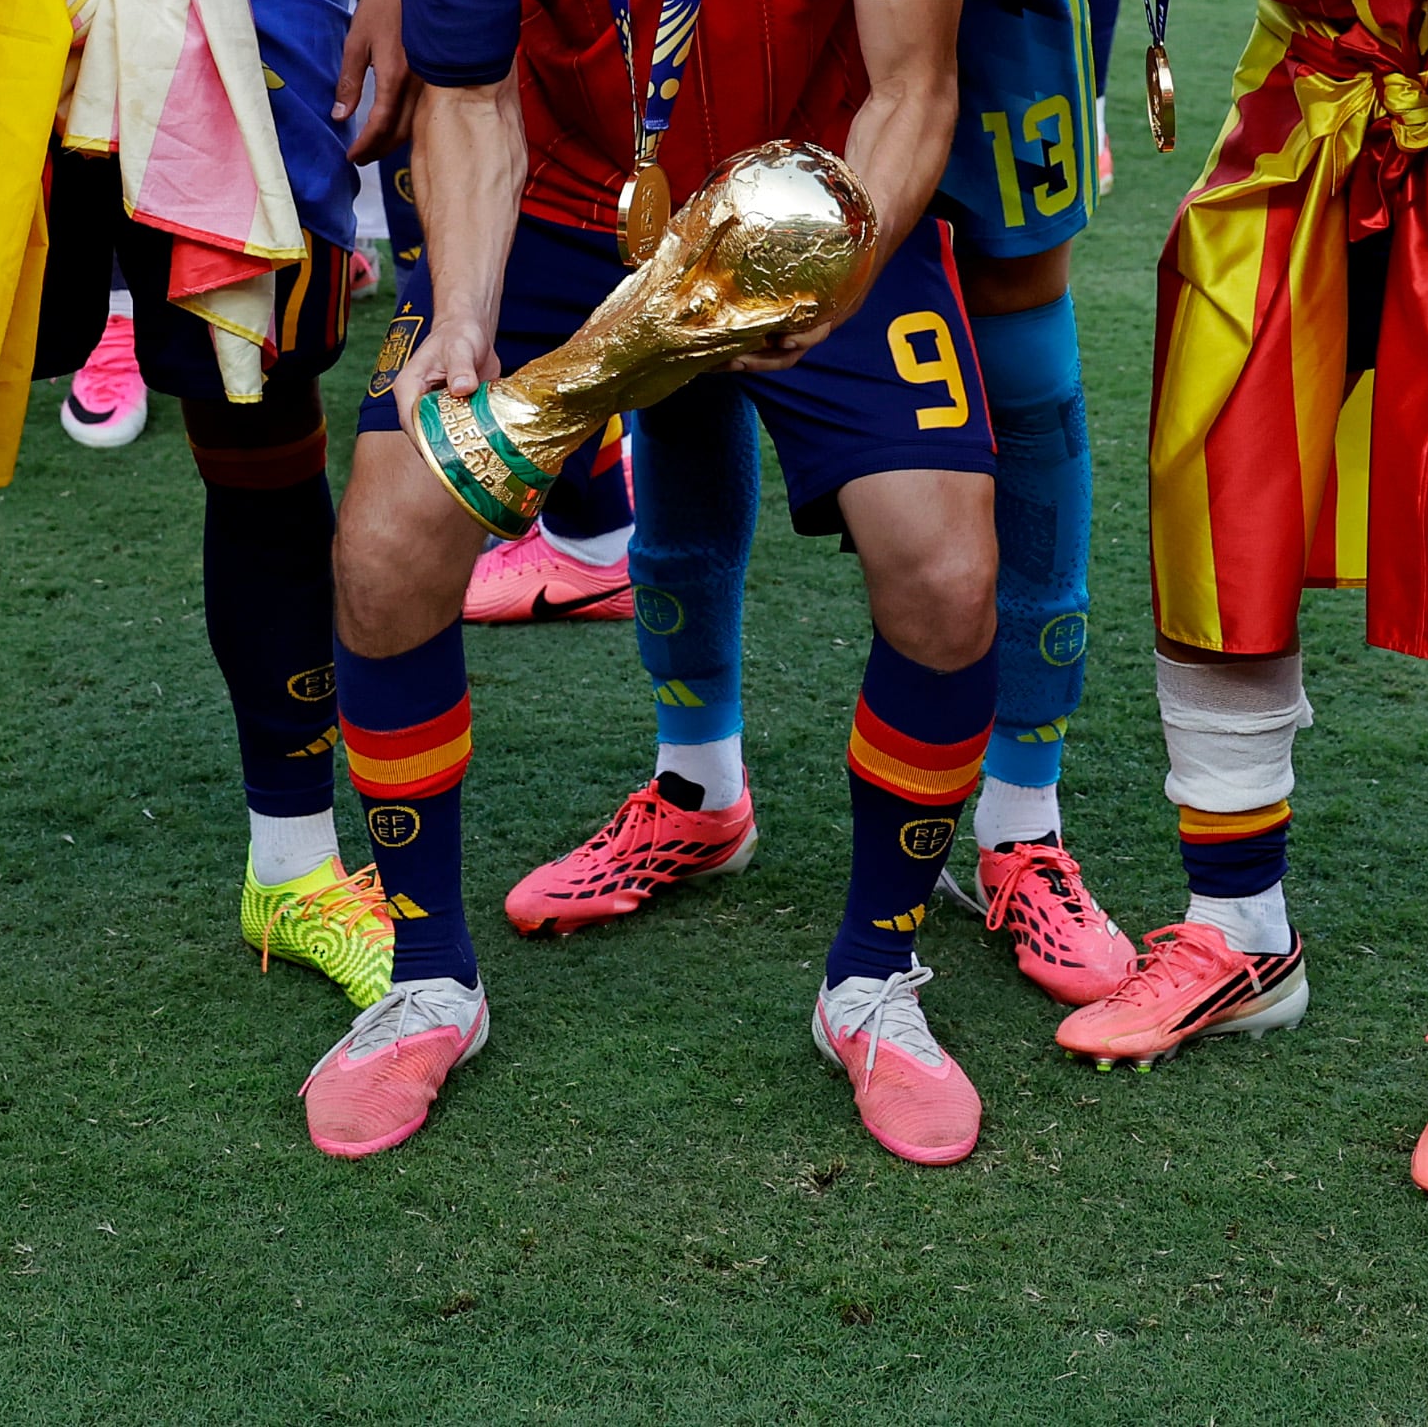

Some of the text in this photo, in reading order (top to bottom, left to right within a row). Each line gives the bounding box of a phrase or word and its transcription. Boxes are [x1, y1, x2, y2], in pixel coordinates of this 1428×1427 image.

[980, 94, 1079, 228] 13
[887, 311, 969, 430] 9
[460, 447, 495, 489] CUP
[1053, 638, 1079, 655] EF
[376, 814, 406, 826] RF
[378, 827, 407, 838] EF
[915, 826, 947, 839] RF
[913, 838, 943, 851] EF
